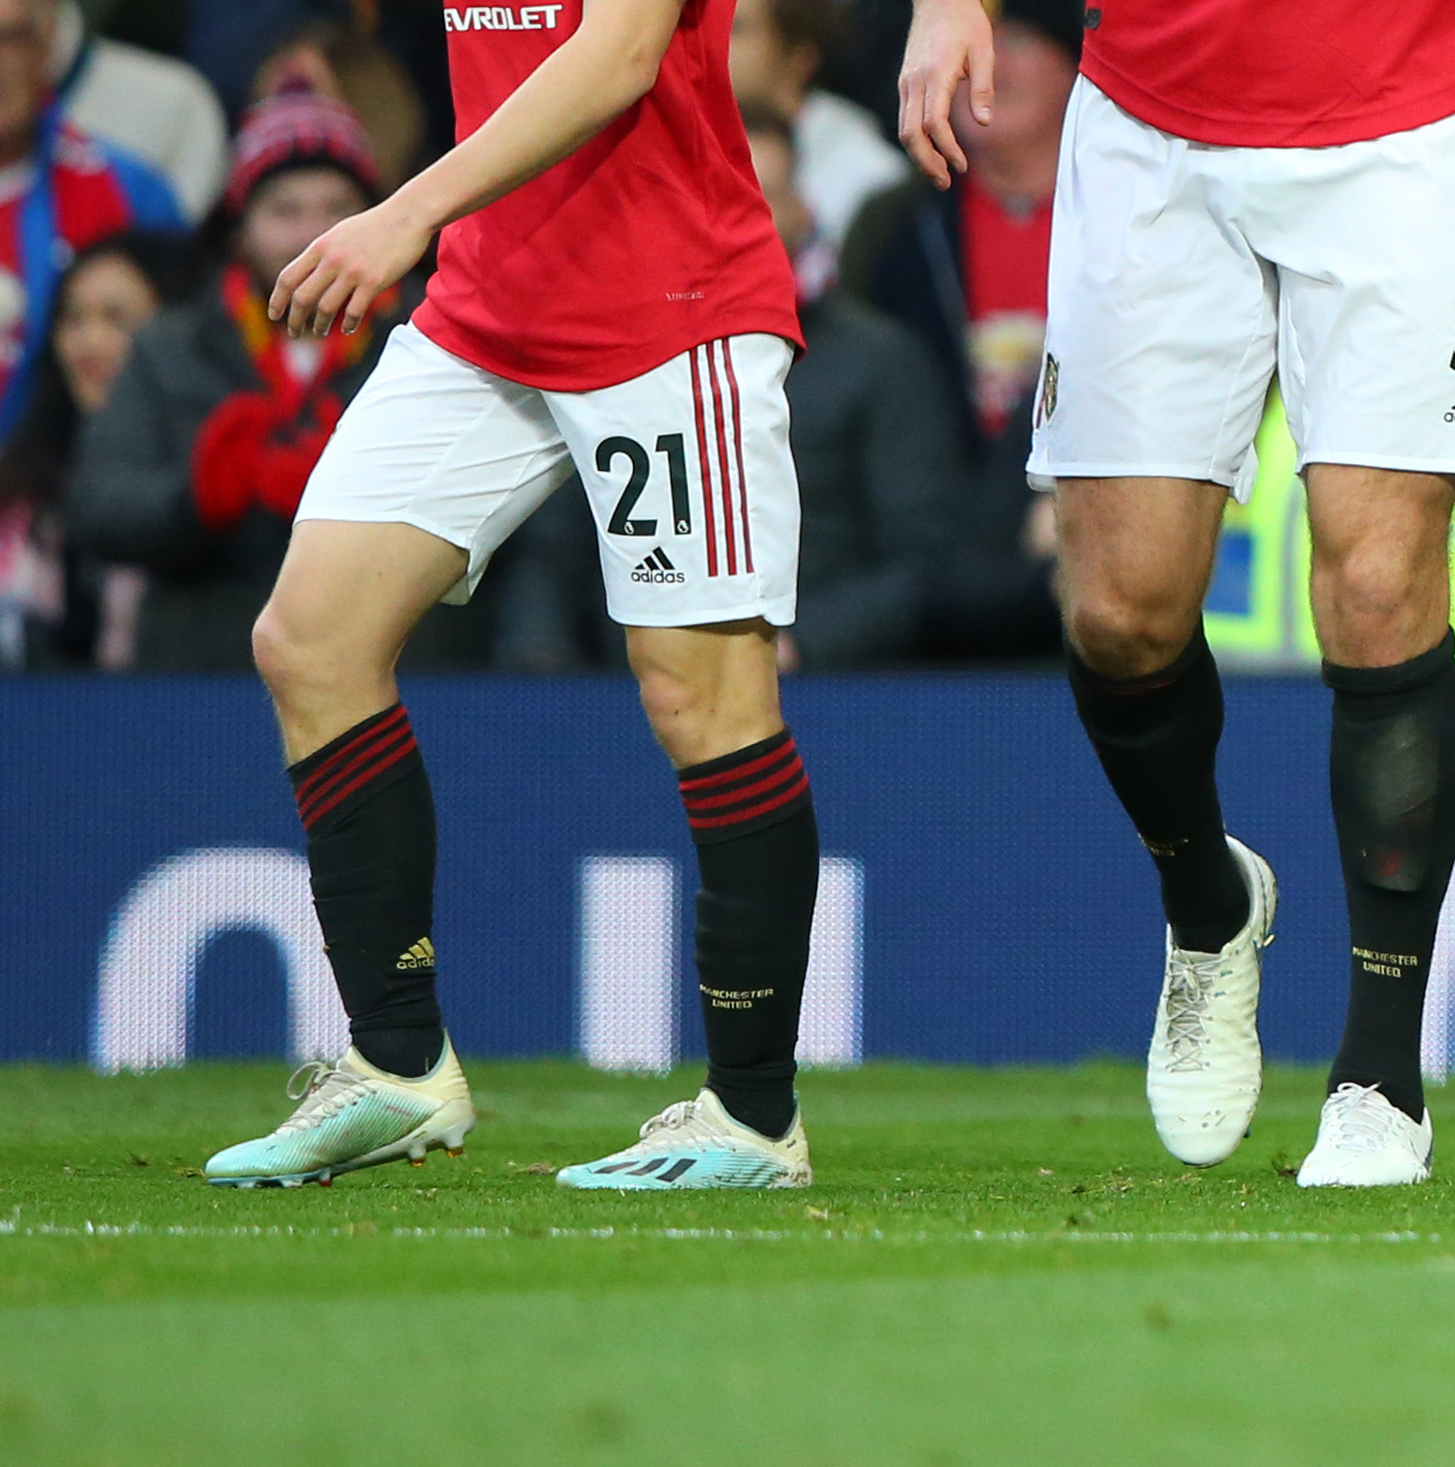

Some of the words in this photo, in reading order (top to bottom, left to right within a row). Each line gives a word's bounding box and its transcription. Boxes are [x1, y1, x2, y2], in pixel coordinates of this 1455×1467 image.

[596, 433, 691, 536] 21
[631, 568, 685, 583] adidas
[1352, 946, 1418, 966] MANCHESTER
[1363, 961, 1401, 978] UNITED
[700, 984, 774, 999] MANCHESTER
[712, 999, 752, 1009] UNITED
